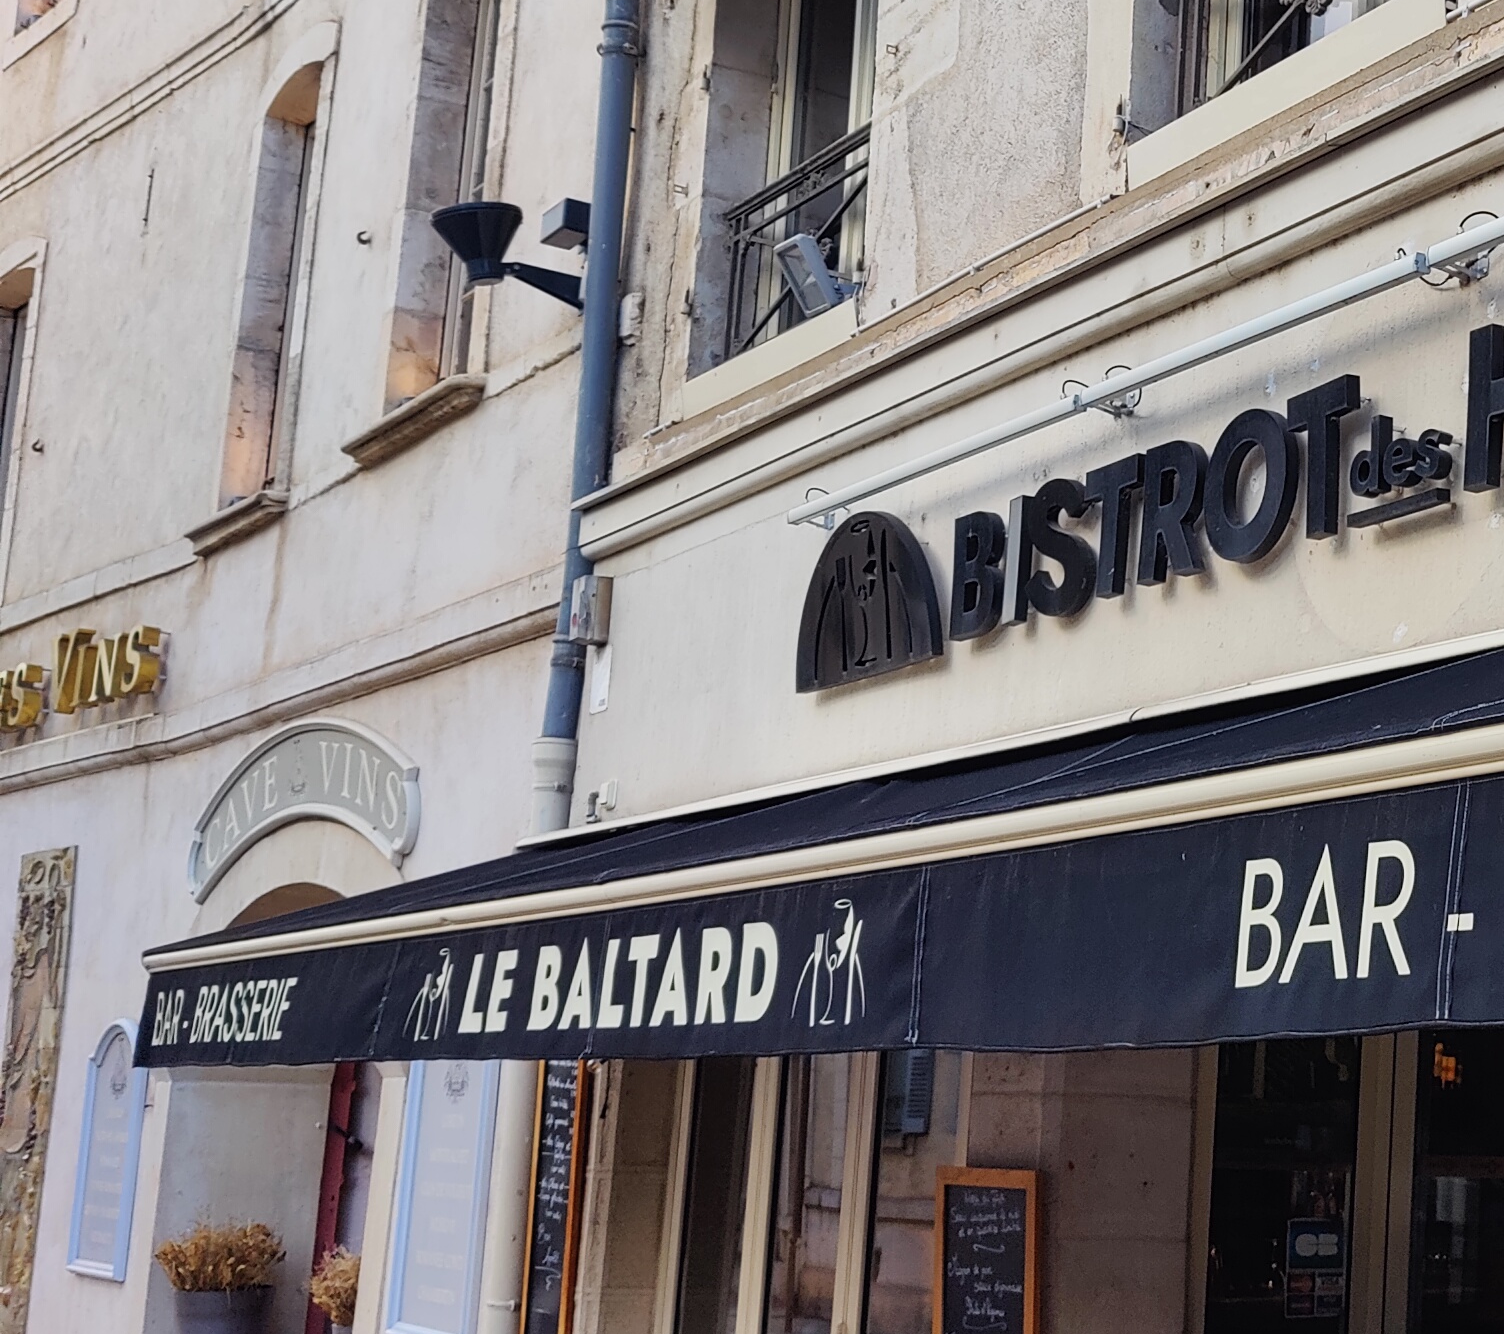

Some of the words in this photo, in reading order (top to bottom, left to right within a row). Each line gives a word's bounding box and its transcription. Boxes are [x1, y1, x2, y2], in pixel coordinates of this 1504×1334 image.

[949, 373, 1361, 642] BISTROT
[1350, 414, 1454, 500] des
[0, 661, 43, 732] S
[52, 624, 162, 714] VINS
[205, 755, 278, 870] CAVE
[318, 740, 402, 830] VINS
[1234, 839, 1417, 989] BAR
[151, 968, 185, 1047] BAR
[188, 976, 299, 1045] BRASSERIE
[457, 948, 519, 1035] LE
[526, 920, 779, 1032] BALTARD
